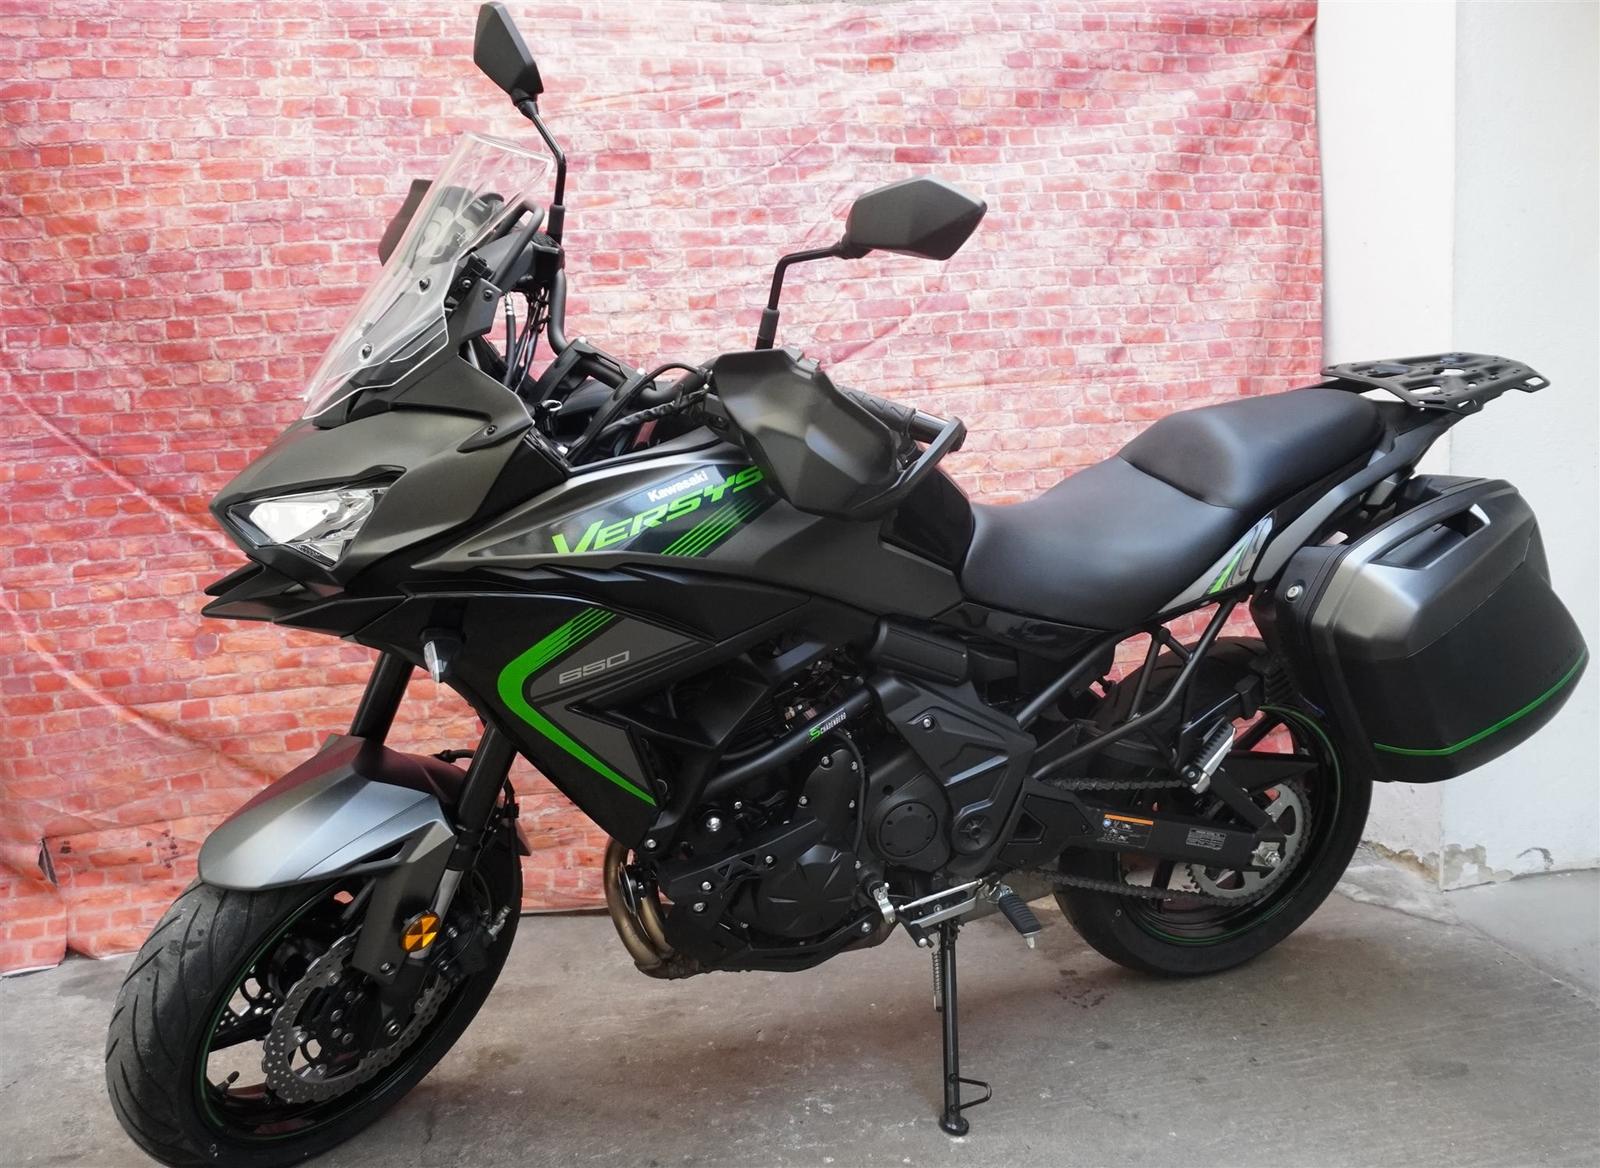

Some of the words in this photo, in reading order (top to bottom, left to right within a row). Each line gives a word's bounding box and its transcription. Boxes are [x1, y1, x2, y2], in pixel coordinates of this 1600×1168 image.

[648, 470, 708, 502] Kawasaki
[552, 465, 764, 554] VERSYS
[559, 650, 630, 684] 650
